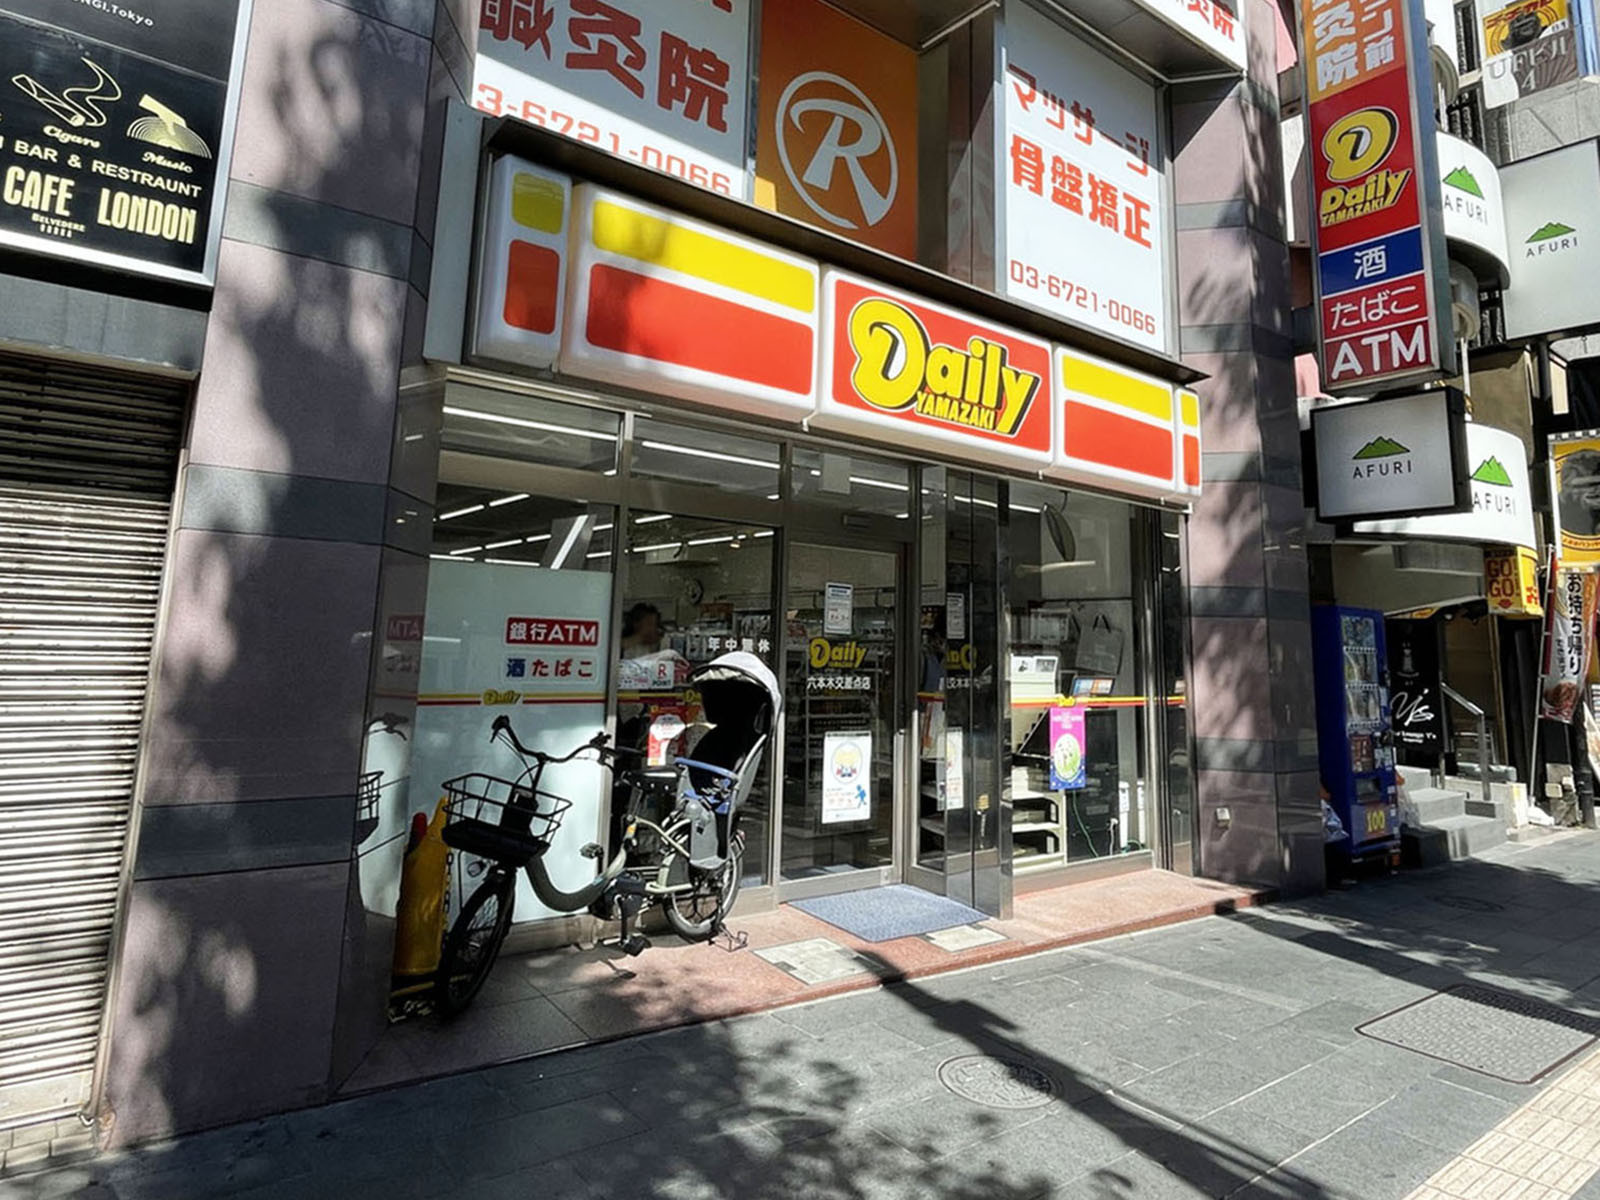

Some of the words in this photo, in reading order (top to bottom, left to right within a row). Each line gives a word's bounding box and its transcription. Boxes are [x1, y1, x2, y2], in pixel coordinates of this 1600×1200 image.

[43, 124, 100, 149] Cigars
[1008, 63, 1148, 177] マッサージ
[15, 139, 58, 163] BAR
[67, 154, 82, 169] &
[91, 159, 202, 198] RESTRAUNT
[3, 165, 75, 217] CAFE
[97, 187, 197, 244] LONDON
[1010, 133, 1152, 250] 骨盤矯正
[1320, 168, 1413, 215] Daily
[1443, 194, 1489, 226] AFURI
[1321, 198, 1388, 228] YAMAZAKI
[1354, 245, 1387, 280] 酒
[1525, 237, 1579, 259] AFURI
[1010, 258, 1156, 336] 03-6721-0066
[1330, 286, 1419, 331] たばこ
[849, 298, 1041, 436] Daily
[1331, 324, 1427, 380] ATM
[916, 391, 997, 430] YAMAZAKI
[1353, 460, 1412, 479] AFURI
[1473, 490, 1516, 516] AFURI
[509, 622, 597, 643] 銀行ATM
[507, 658, 525, 678] 酒
[532, 658, 593, 678] たばこ
[810, 637, 868, 669] Daily
